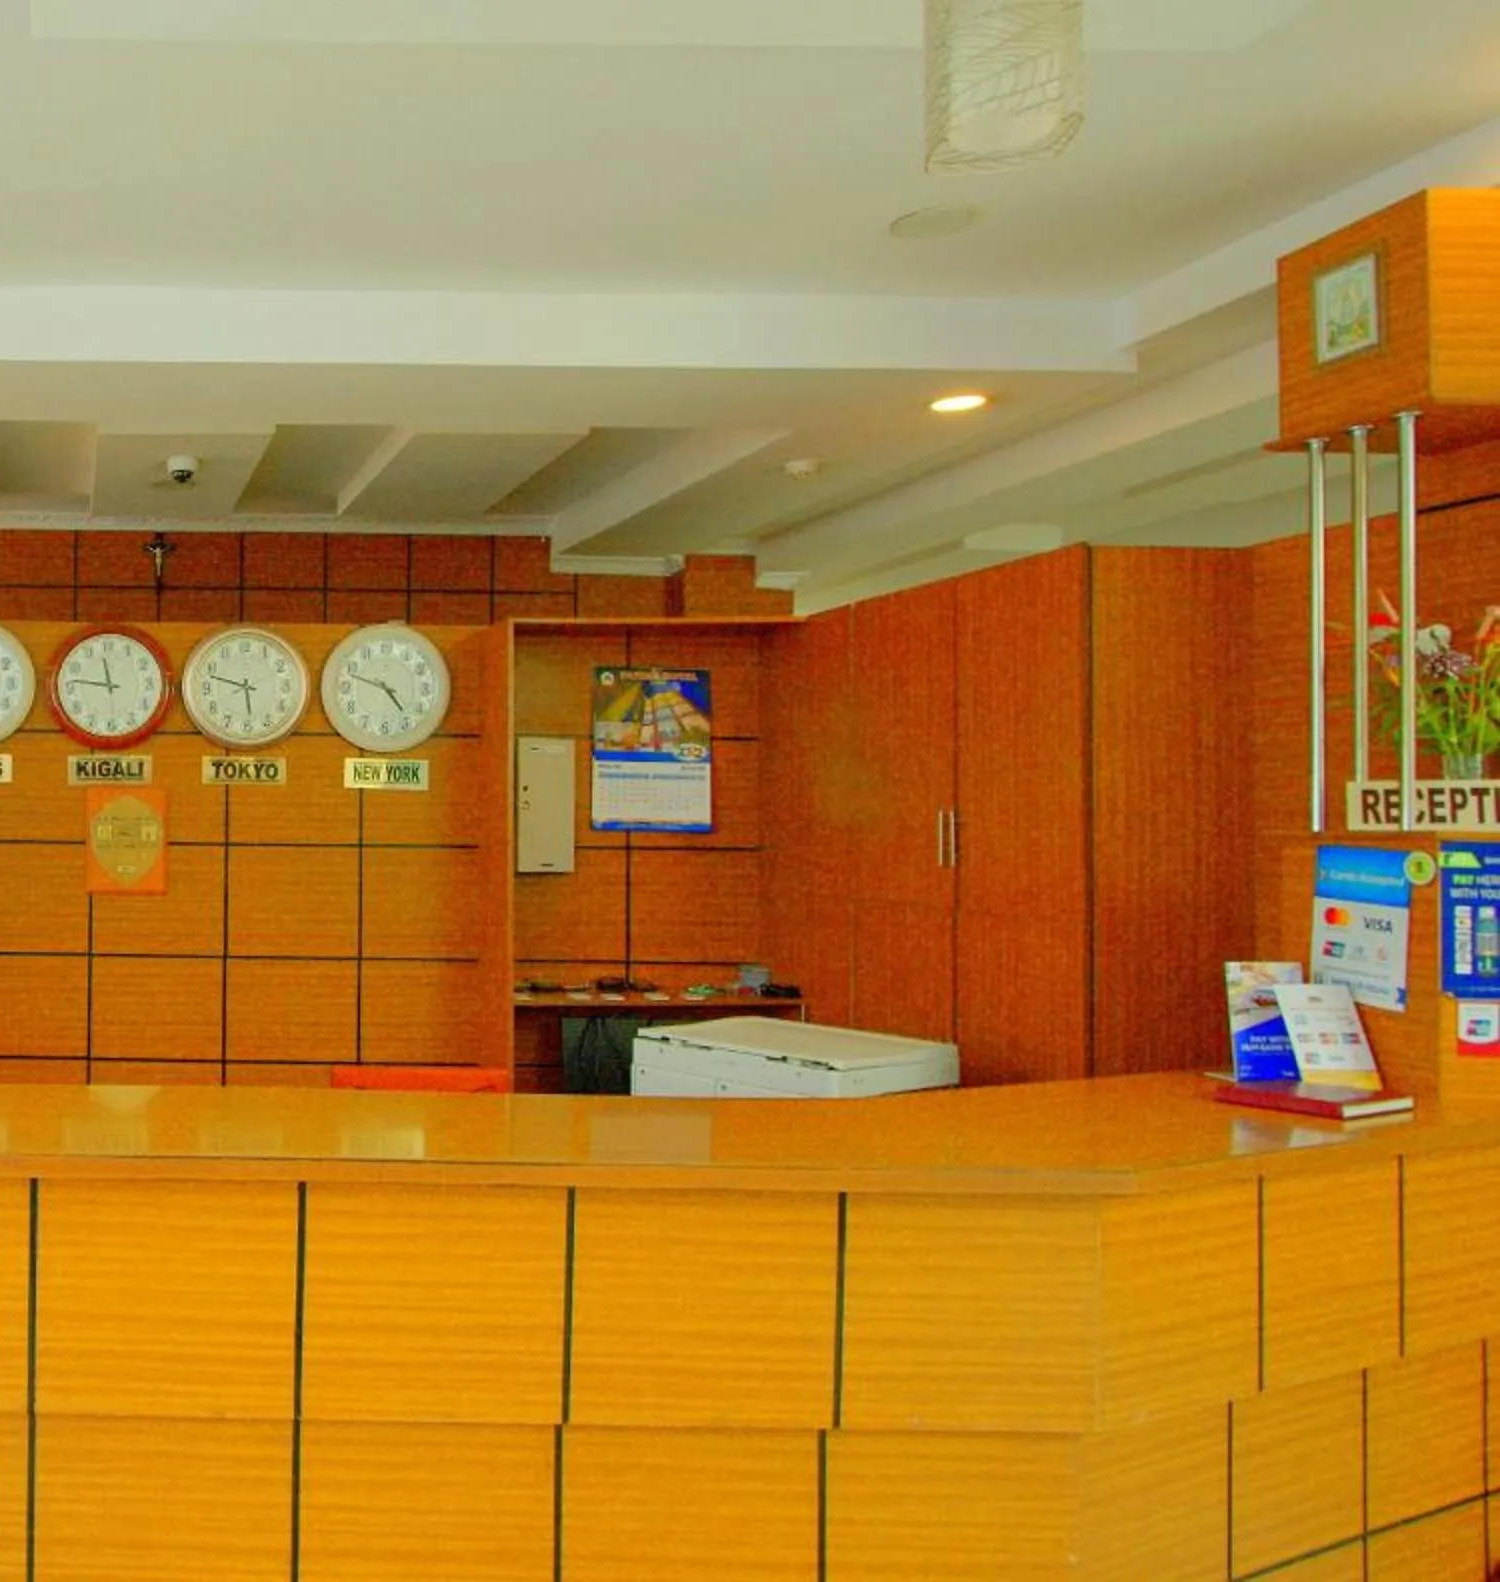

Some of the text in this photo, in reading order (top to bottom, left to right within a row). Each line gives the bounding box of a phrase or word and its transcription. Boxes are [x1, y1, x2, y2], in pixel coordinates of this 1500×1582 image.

[76, 761, 144, 778] KIGALI
[212, 762, 278, 779] TOKYO
[353, 763, 420, 783] NEW YORK
[1363, 917, 1394, 934] VISA
